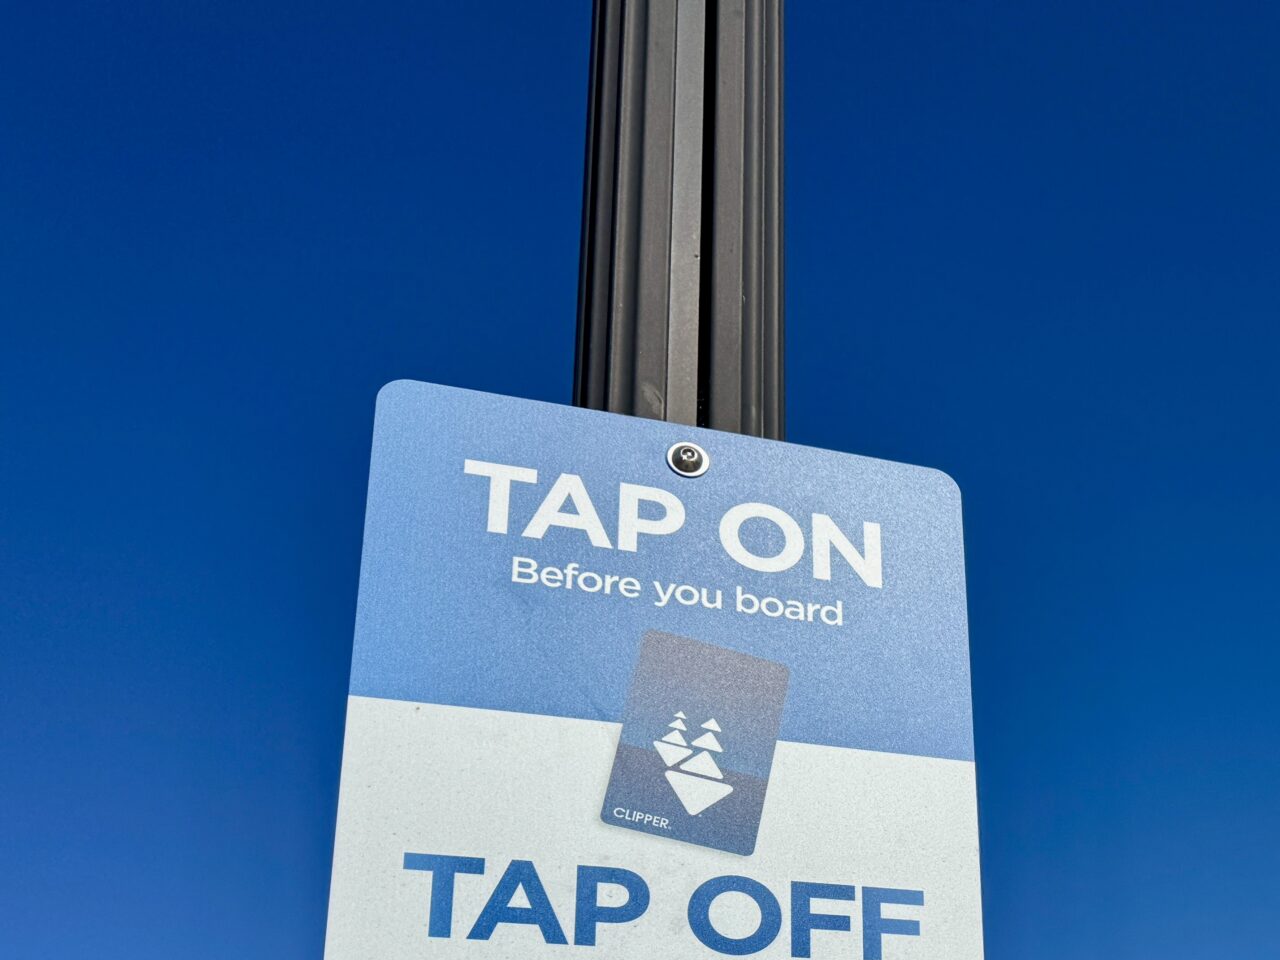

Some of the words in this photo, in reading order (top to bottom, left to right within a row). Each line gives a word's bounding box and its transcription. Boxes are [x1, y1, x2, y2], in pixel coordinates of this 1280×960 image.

[463, 459, 686, 552] TAP
[718, 500, 884, 589] ON
[512, 556, 641, 599] Before
[653, 580, 723, 611] you
[735, 585, 845, 628] board
[613, 807, 669, 829] CLIPPER
[403, 852, 650, 946] TAP
